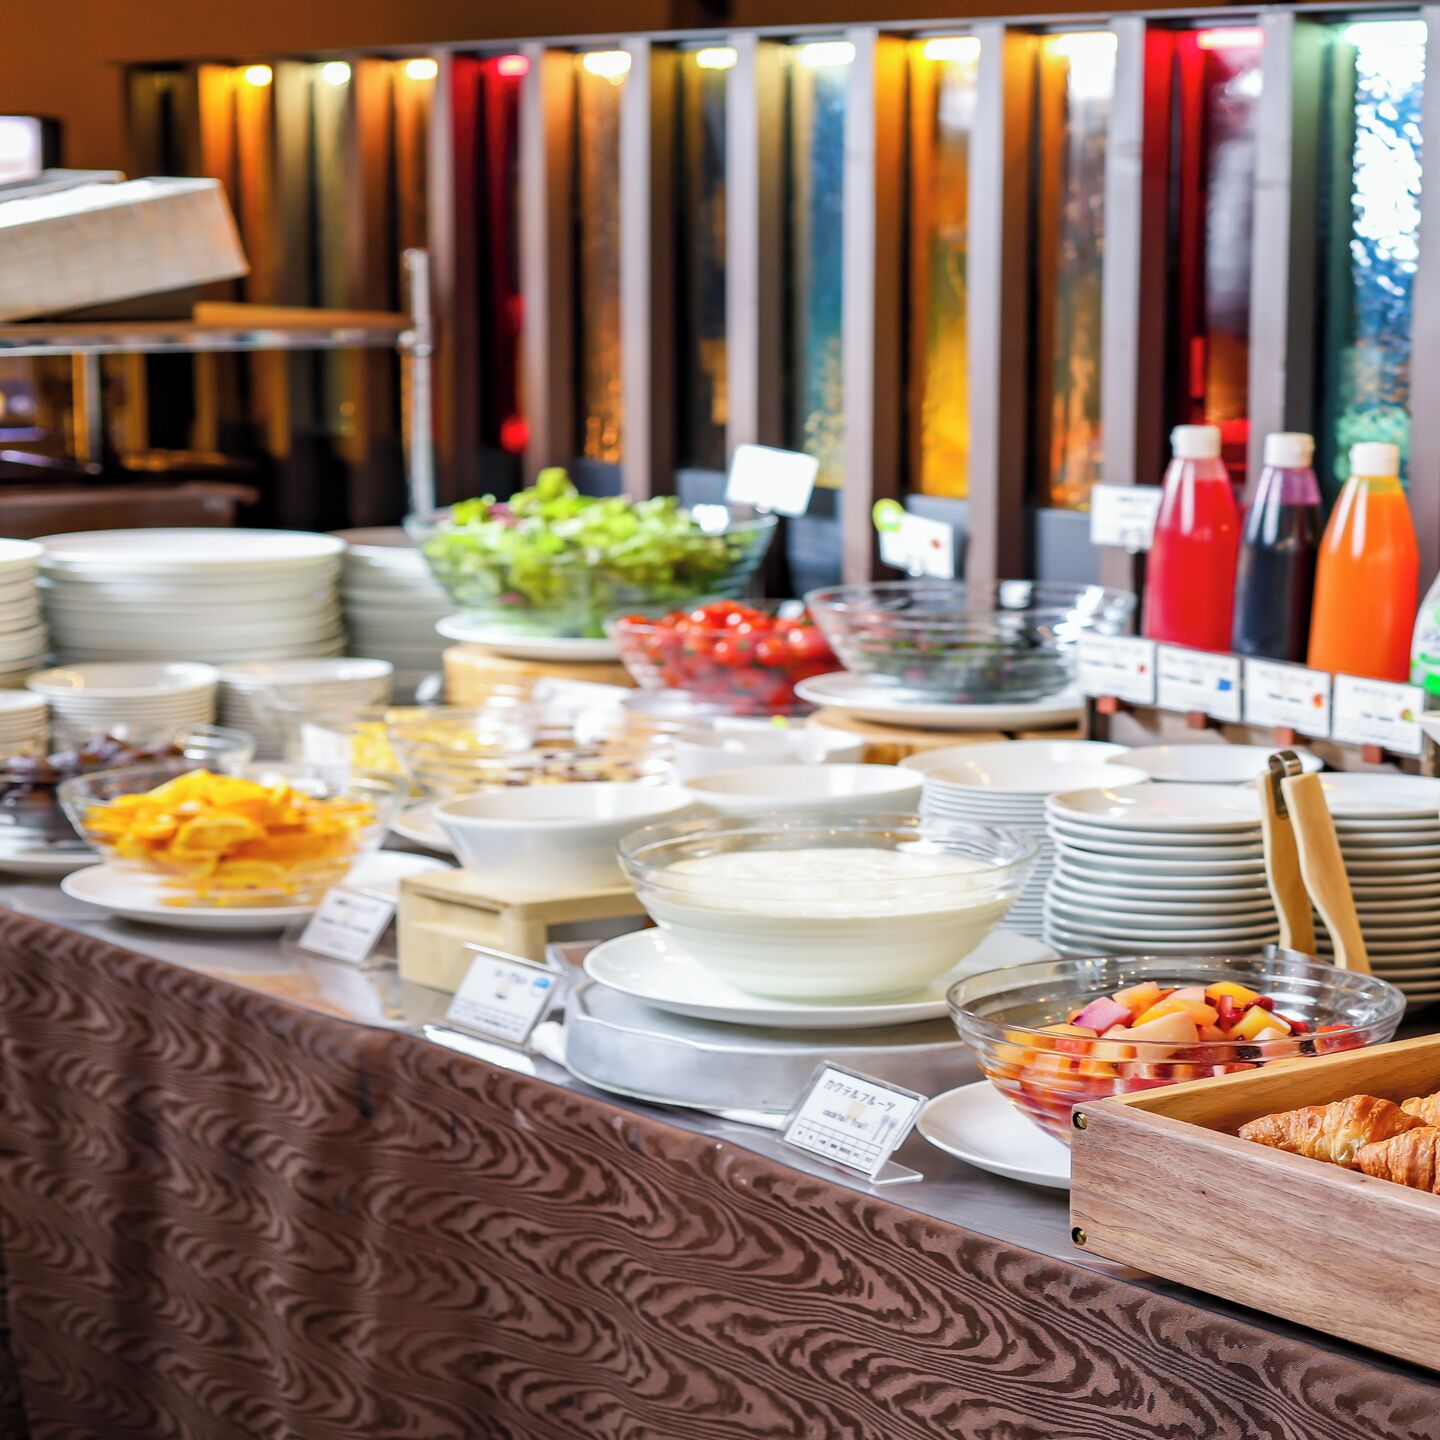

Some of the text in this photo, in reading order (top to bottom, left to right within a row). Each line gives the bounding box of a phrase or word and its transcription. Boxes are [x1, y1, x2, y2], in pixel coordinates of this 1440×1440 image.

[823, 1079, 896, 1112] カクテルフルーツ
